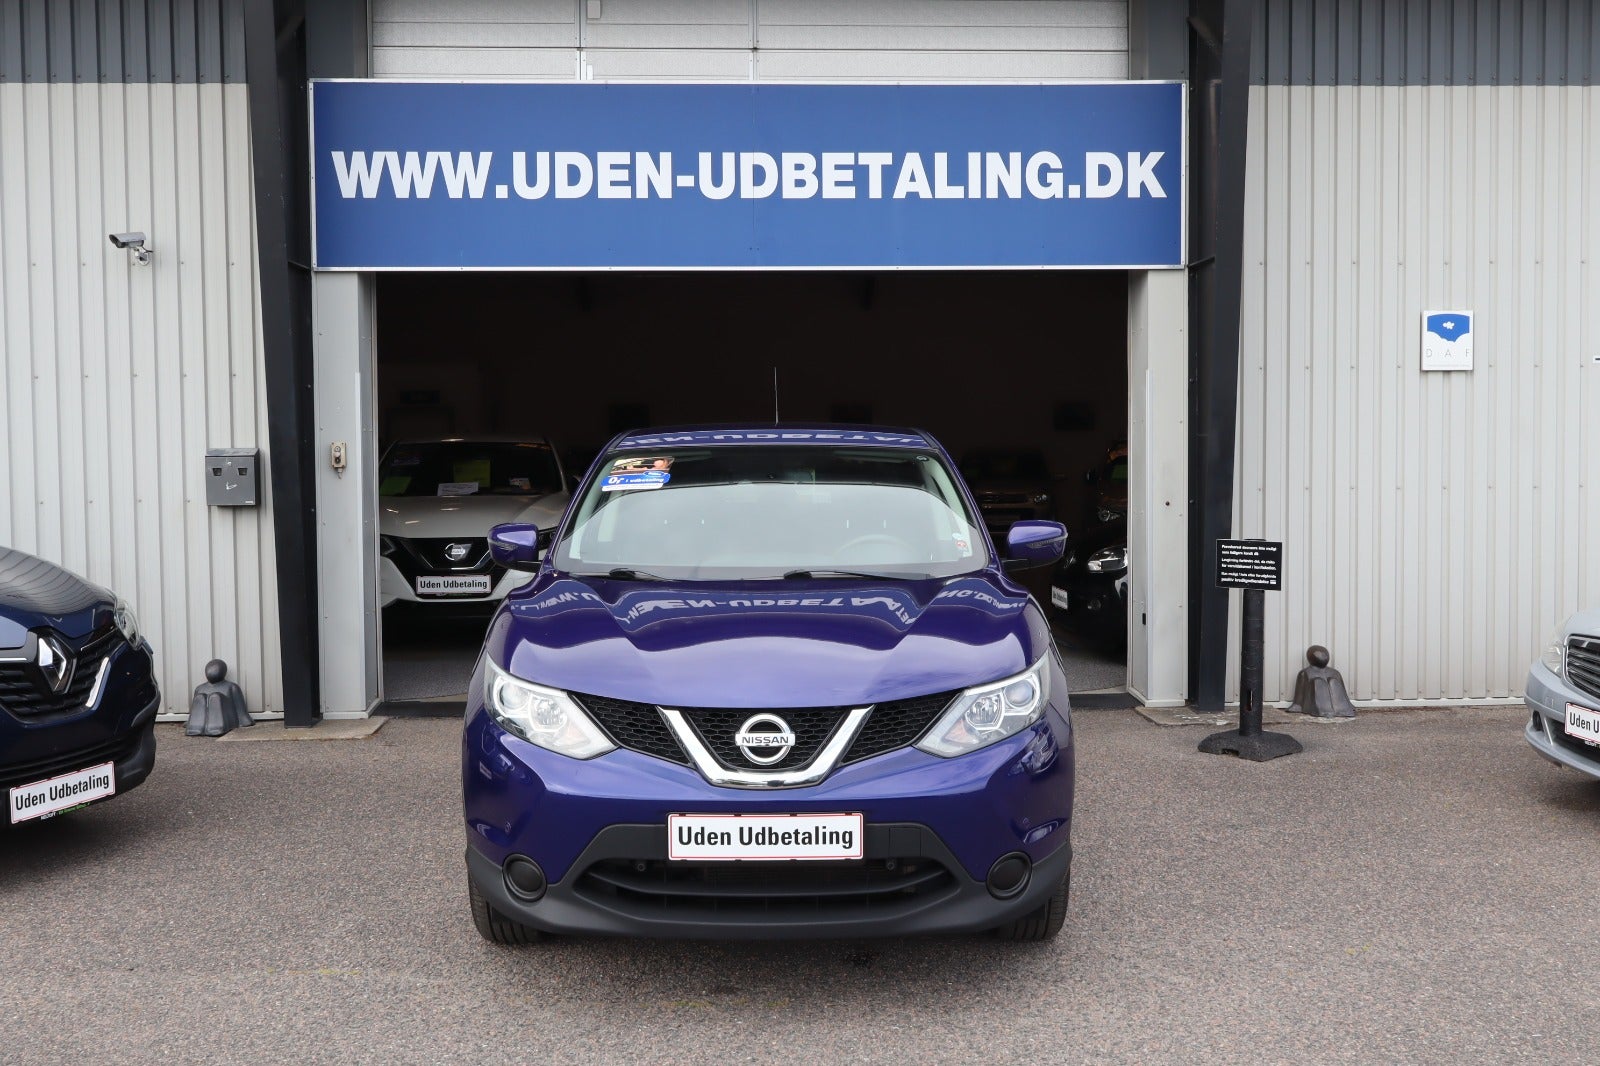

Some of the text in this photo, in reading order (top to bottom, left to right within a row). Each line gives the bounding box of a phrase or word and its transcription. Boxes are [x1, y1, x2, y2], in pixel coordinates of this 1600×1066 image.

[331, 151, 1167, 199] WWW.UDEN-UDBETALING.DK
[420, 579, 487, 589] Uden Udbetaling
[1569, 711, 1591, 731] Uden
[741, 736, 789, 745] NISSAN
[15, 774, 109, 811] Uden Udbetaling
[678, 825, 853, 850] Uden Udbetaling
